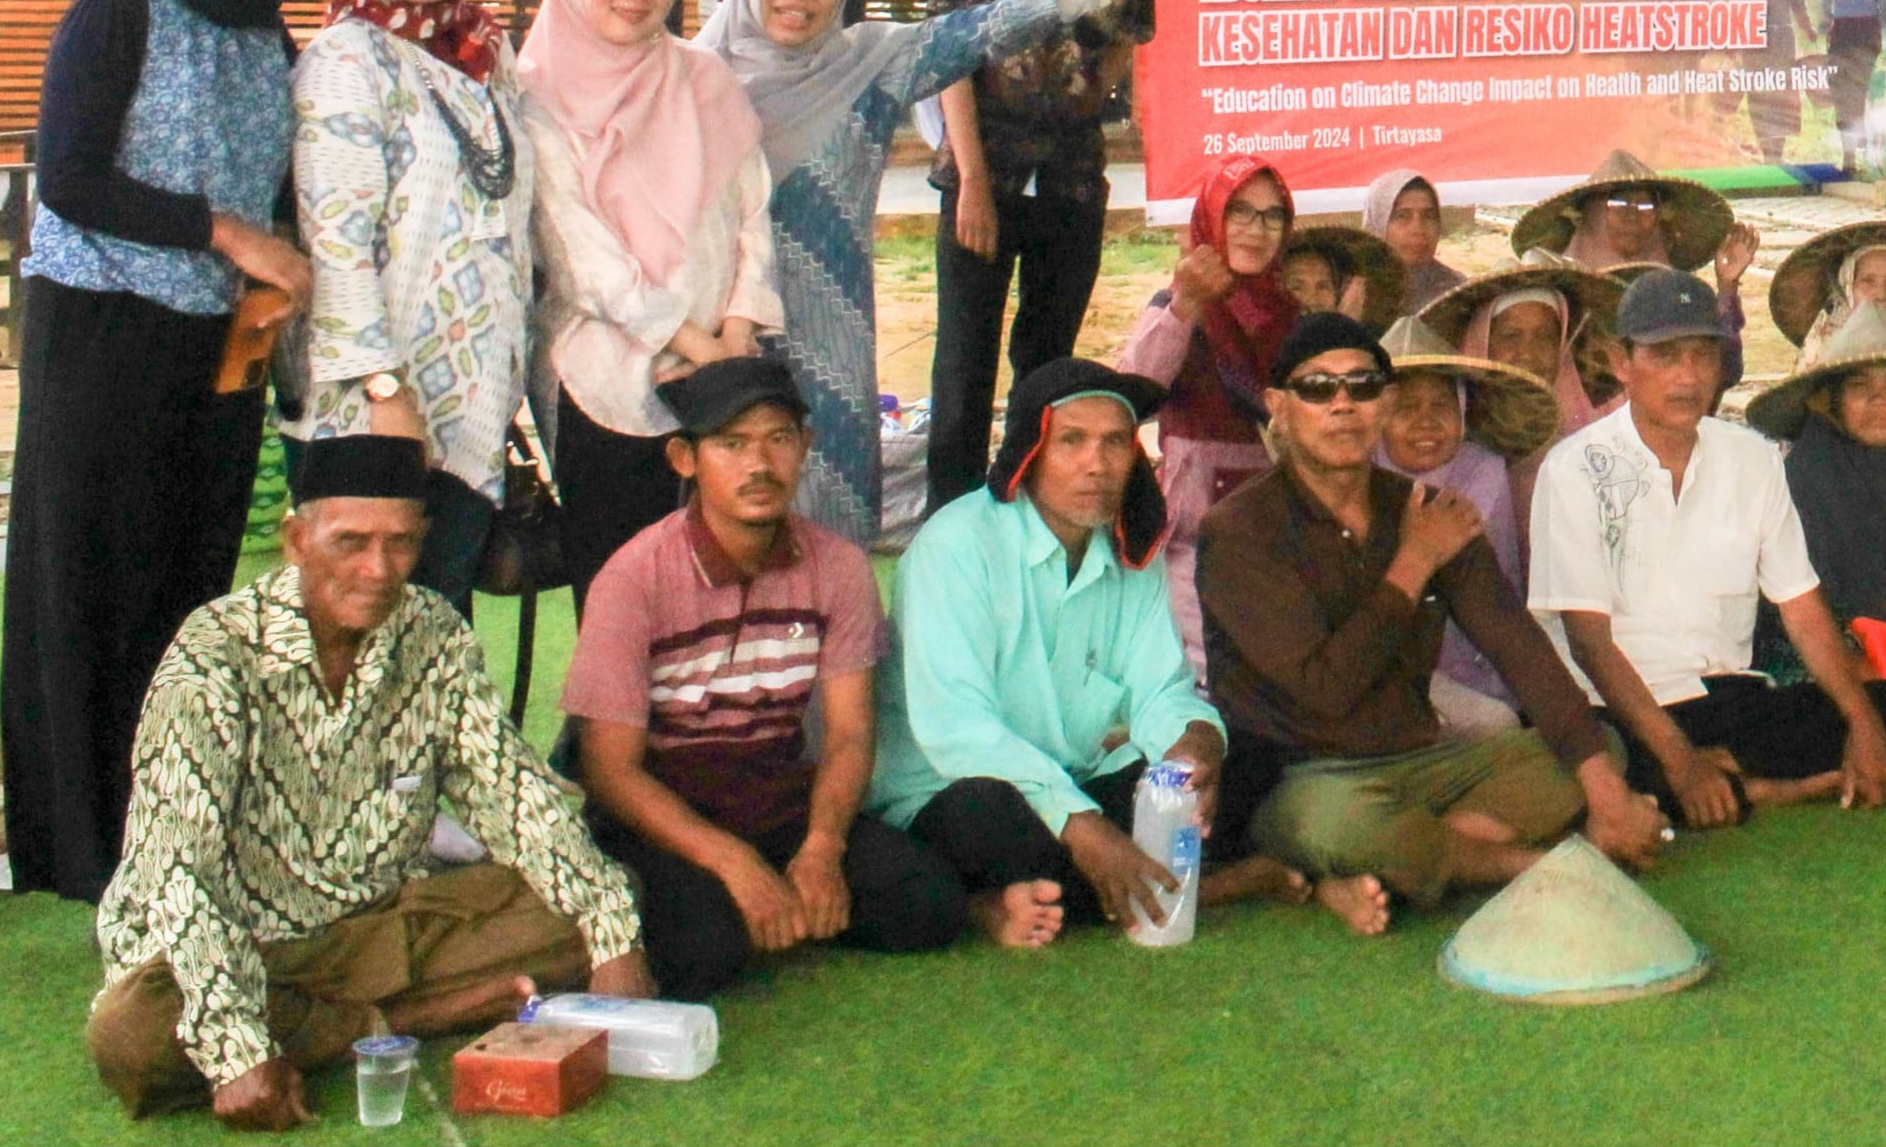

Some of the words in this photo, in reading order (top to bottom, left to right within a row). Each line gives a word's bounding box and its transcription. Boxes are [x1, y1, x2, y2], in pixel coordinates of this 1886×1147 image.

[1199, 7, 1385, 66] KESEHATAN
[1389, 5, 1458, 60] DAN
[1462, 3, 1575, 58] RESIKO
[1580, 0, 1768, 53] HEATSTROKE
[1202, 83, 1307, 114] “Education
[1312, 88, 1336, 109] on
[1340, 79, 1411, 107] Climate
[1415, 77, 1483, 105] Change
[1488, 74, 1552, 103] Impact
[1557, 75, 1580, 99] on
[1585, 72, 1642, 98] Health
[1646, 70, 1680, 95] and
[1684, 69, 1725, 93] Heat
[1729, 67, 1786, 92] Stroke
[1791, 65, 1839, 90] Risk”
[1203, 134, 1223, 155] 26
[1227, 129, 1308, 154] September
[1312, 127, 1350, 149] 2024
[1372, 124, 1442, 147] Tirtayasa
